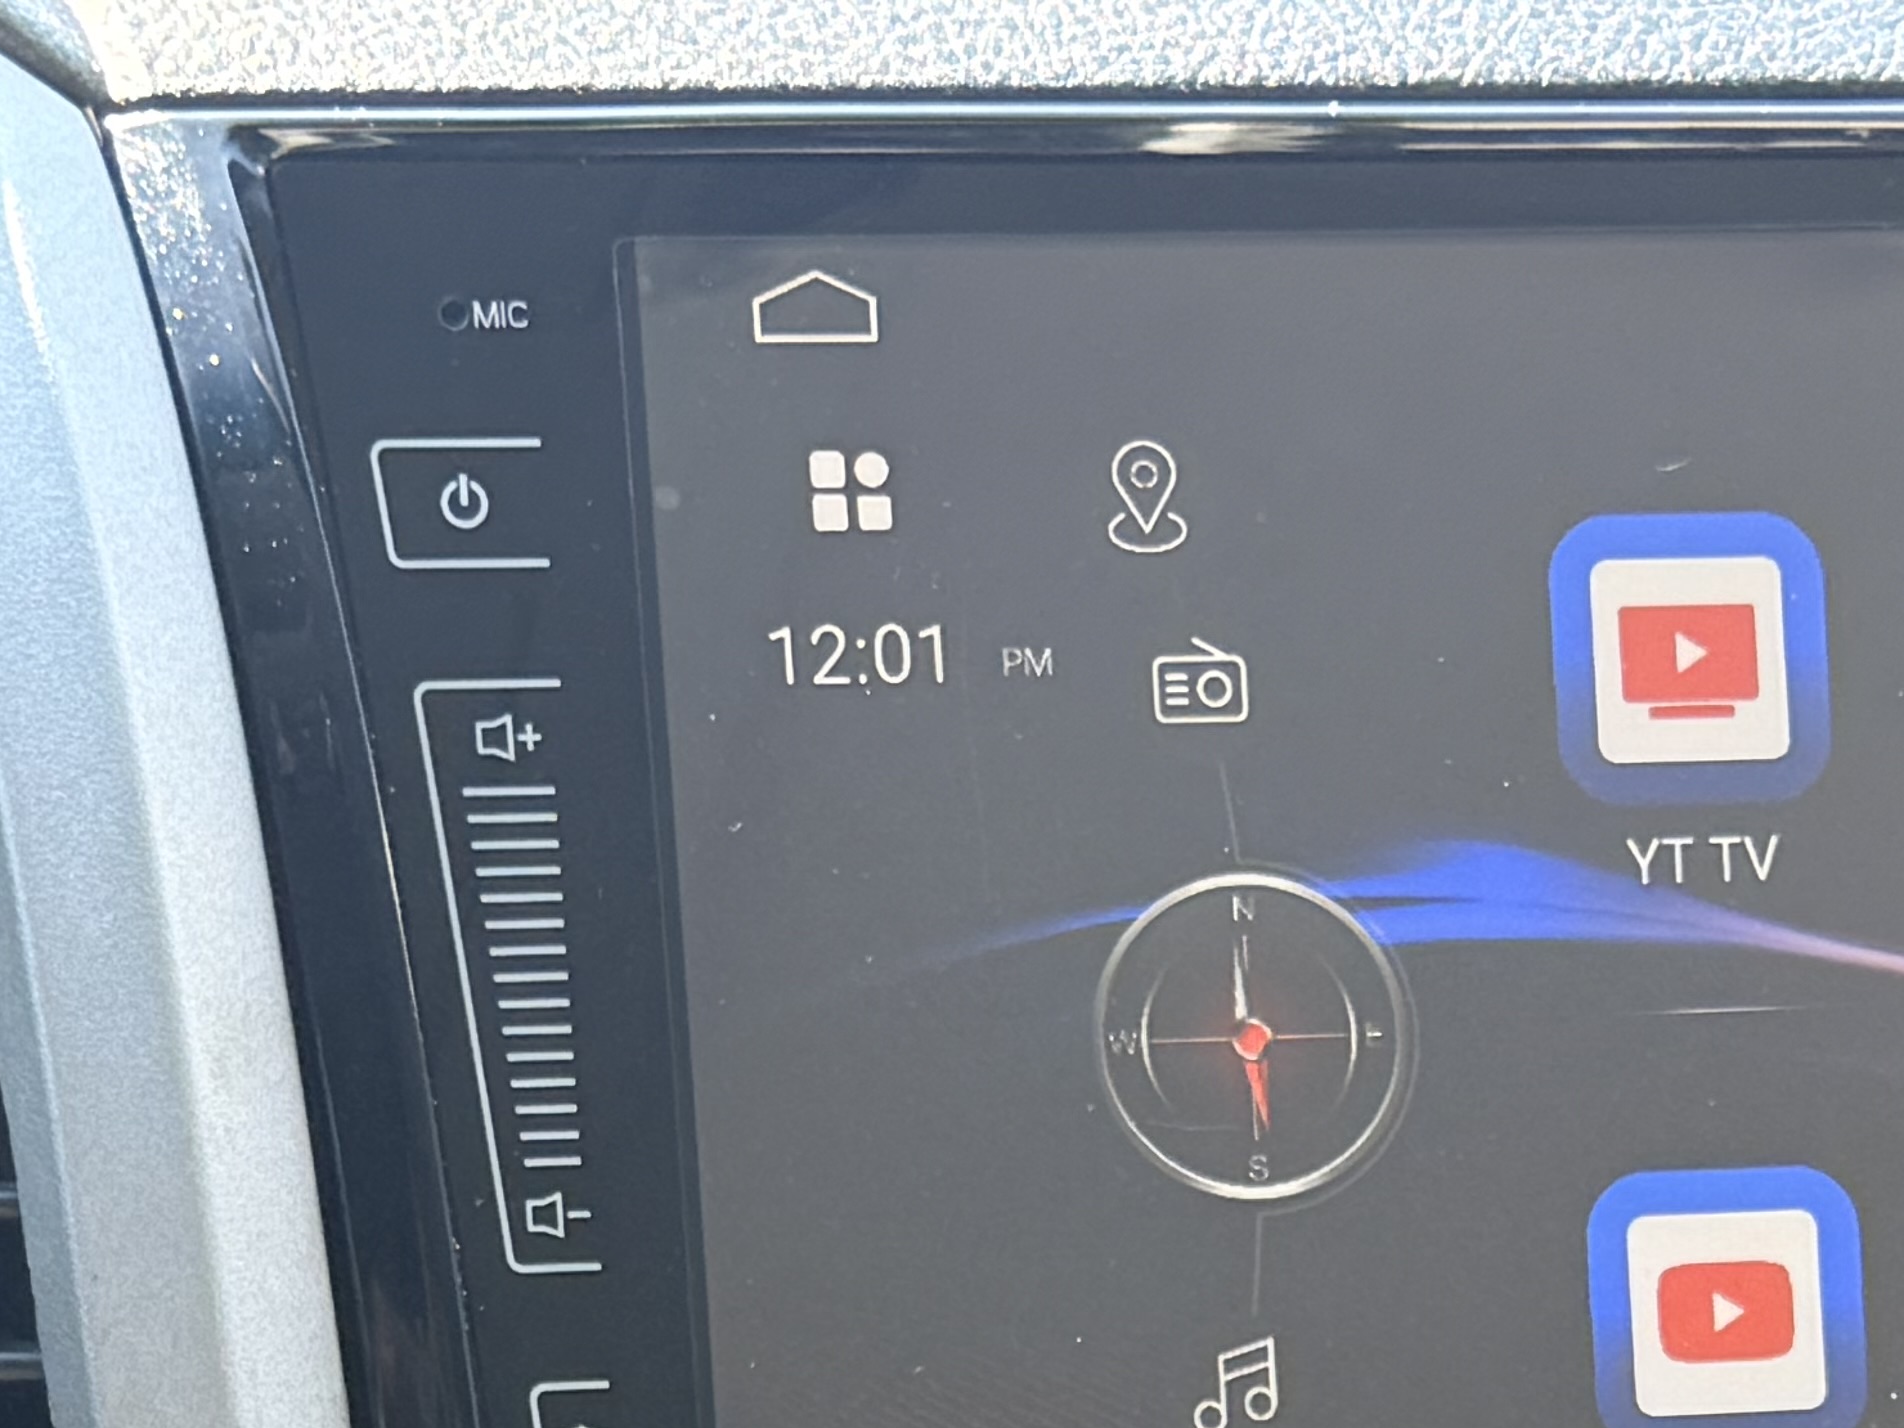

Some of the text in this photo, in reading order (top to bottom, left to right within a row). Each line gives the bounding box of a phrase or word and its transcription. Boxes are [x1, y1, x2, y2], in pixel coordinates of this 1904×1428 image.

[472, 300, 529, 329] MIC
[768, 623, 1053, 686] 12:01 PM
[1626, 835, 1780, 885] YT TV
[1233, 895, 1255, 921] N
[1248, 1154, 1269, 1181] S
